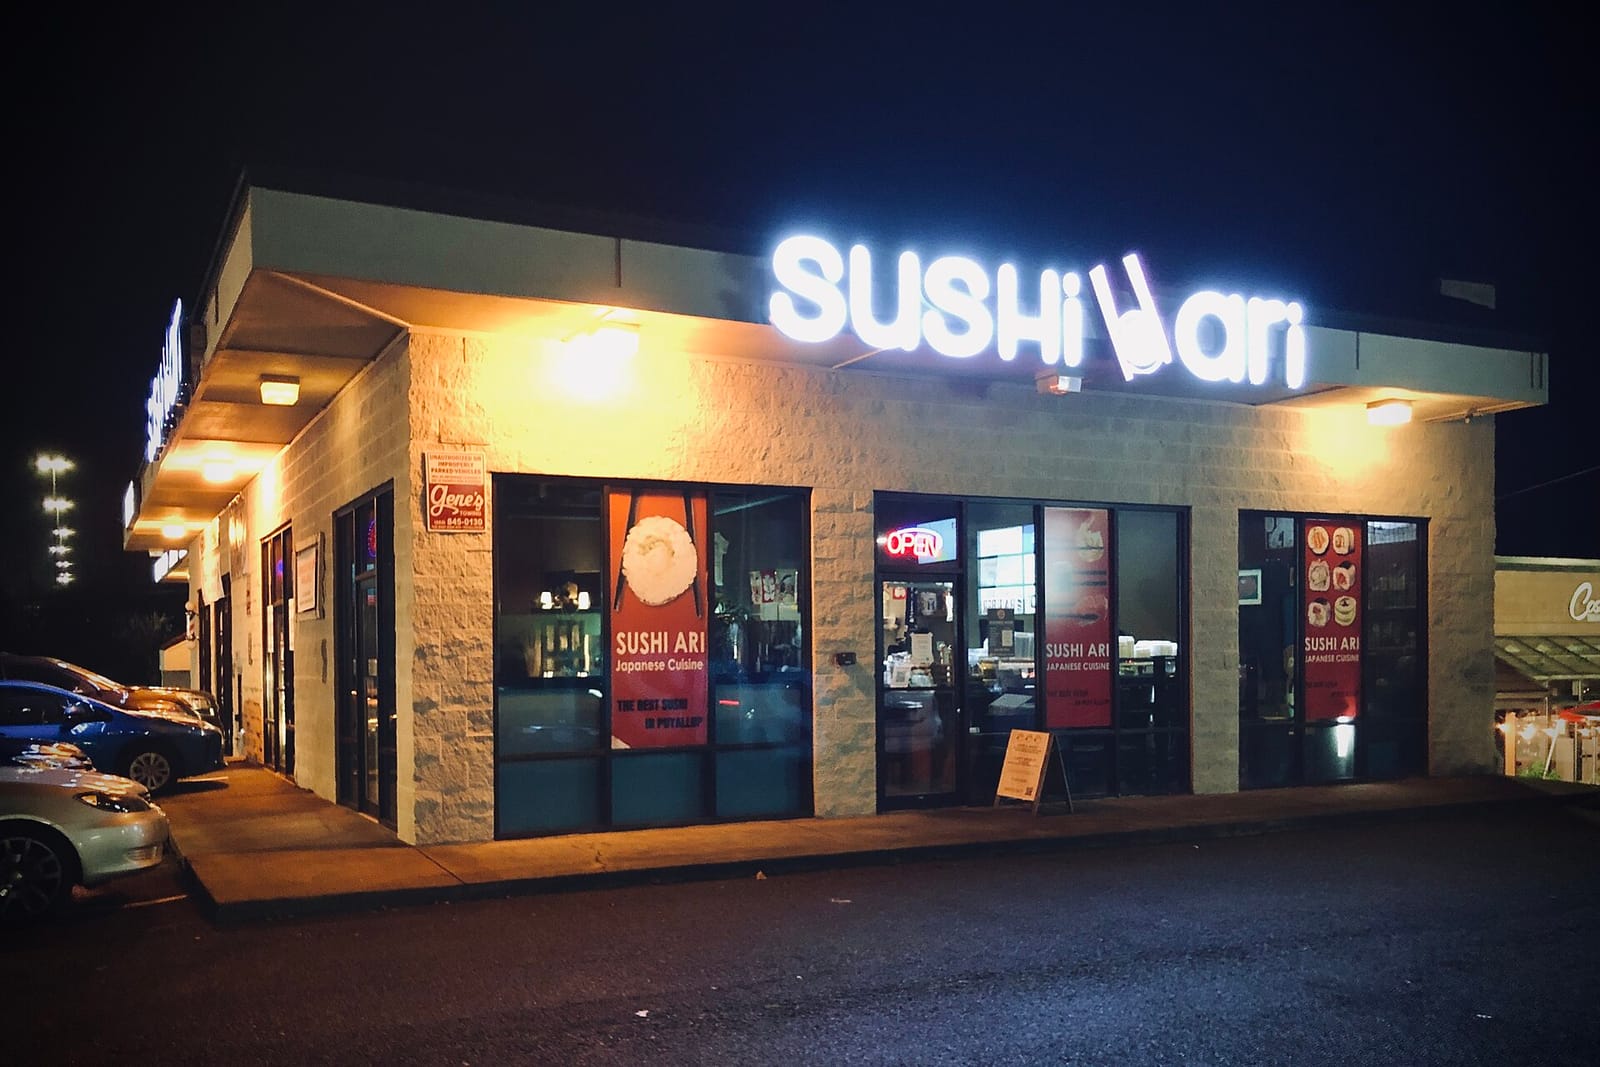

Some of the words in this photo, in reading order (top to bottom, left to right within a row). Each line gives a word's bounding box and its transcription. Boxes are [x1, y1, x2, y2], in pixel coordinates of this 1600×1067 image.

[1175, 290, 1305, 389] ari
[887, 531, 940, 558] OPEN
[616, 631, 668, 655] SUSHI
[674, 631, 705, 653] ARI
[1046, 643, 1083, 657] SUSHI
[1088, 643, 1110, 657] ARI
[1305, 637, 1337, 651] SUSHI
[1340, 637, 1360, 650] ARI
[616, 660, 665, 674] Japanese
[667, 658, 704, 671] Cuisine
[1047, 662, 1081, 671] JAPANESE
[1082, 662, 1110, 671] CUISINE
[617, 699, 634, 712] THE
[637, 699, 659, 711] BEST
